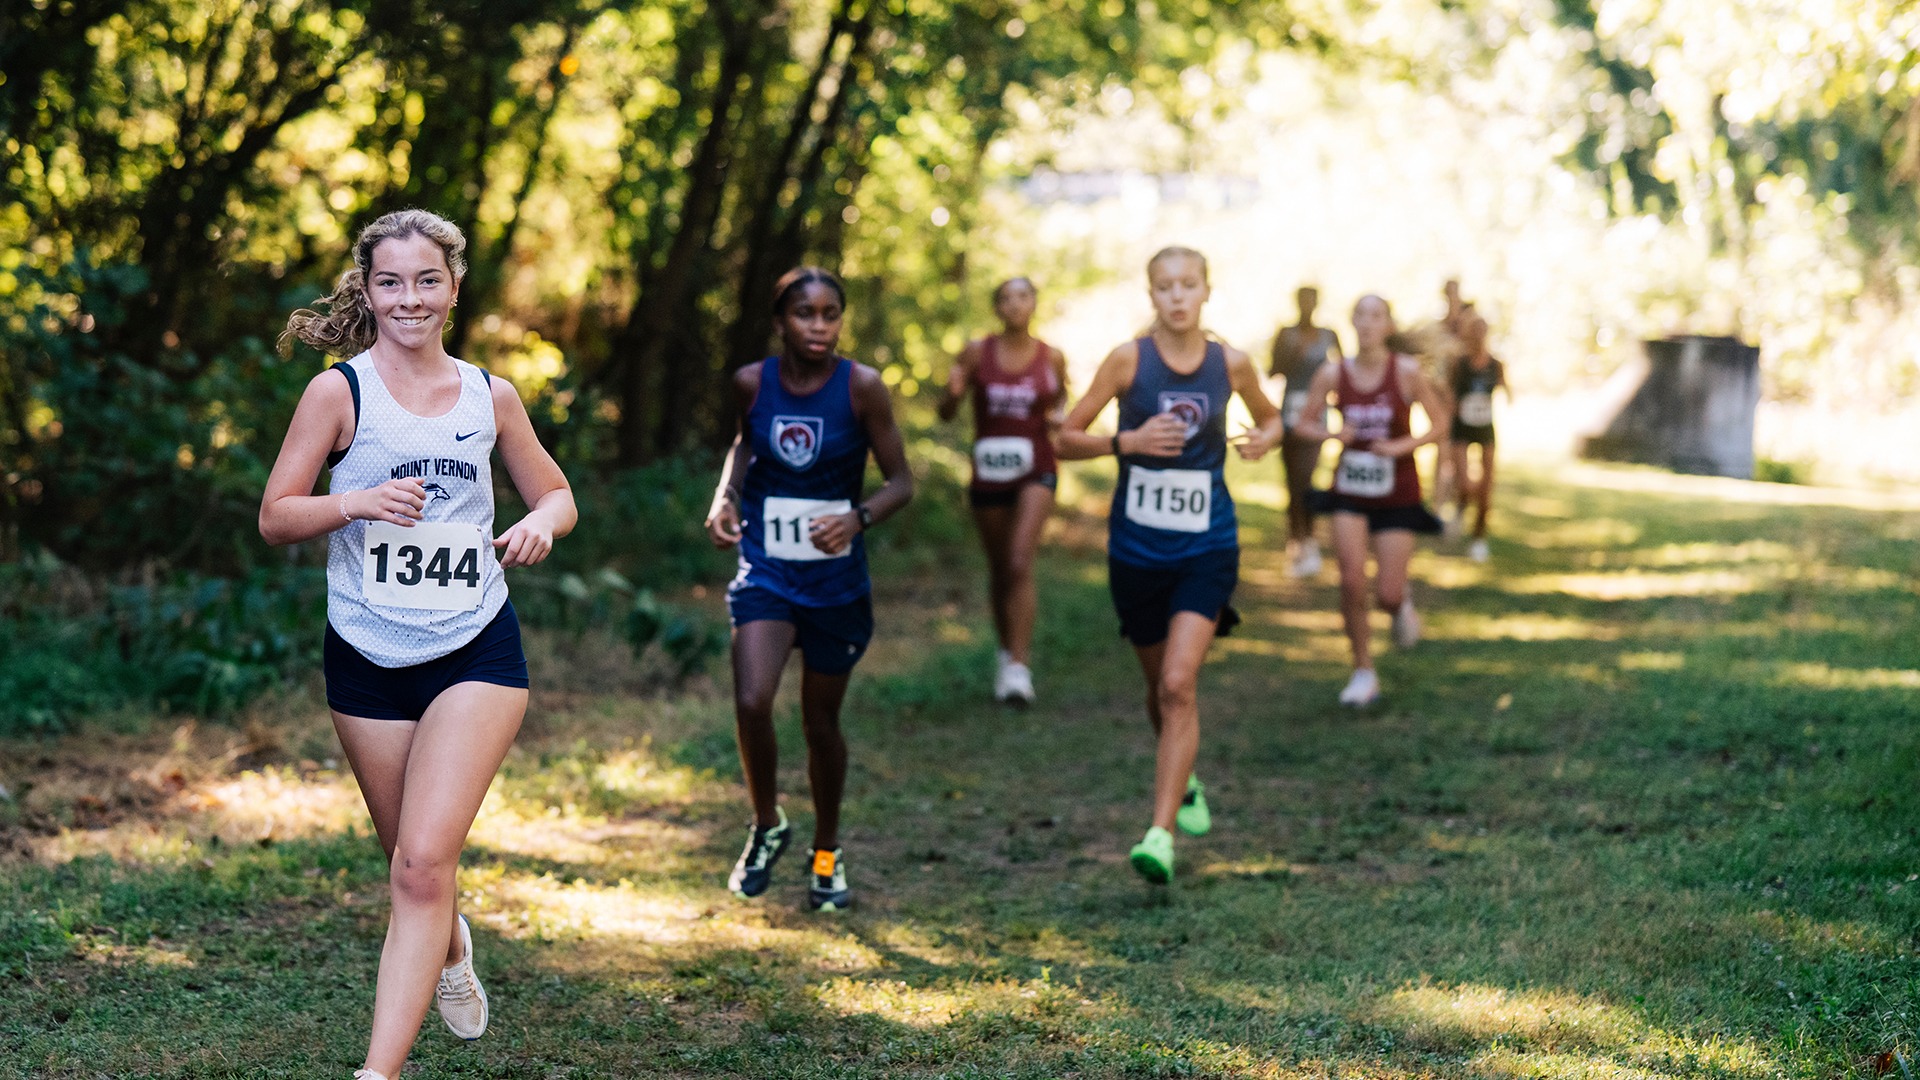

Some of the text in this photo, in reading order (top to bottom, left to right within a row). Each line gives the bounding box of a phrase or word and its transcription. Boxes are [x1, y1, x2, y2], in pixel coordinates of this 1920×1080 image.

[390, 458, 477, 483] MOUNT VERNON
[1135, 484, 1205, 514] 1150
[369, 542, 480, 588] 1344
